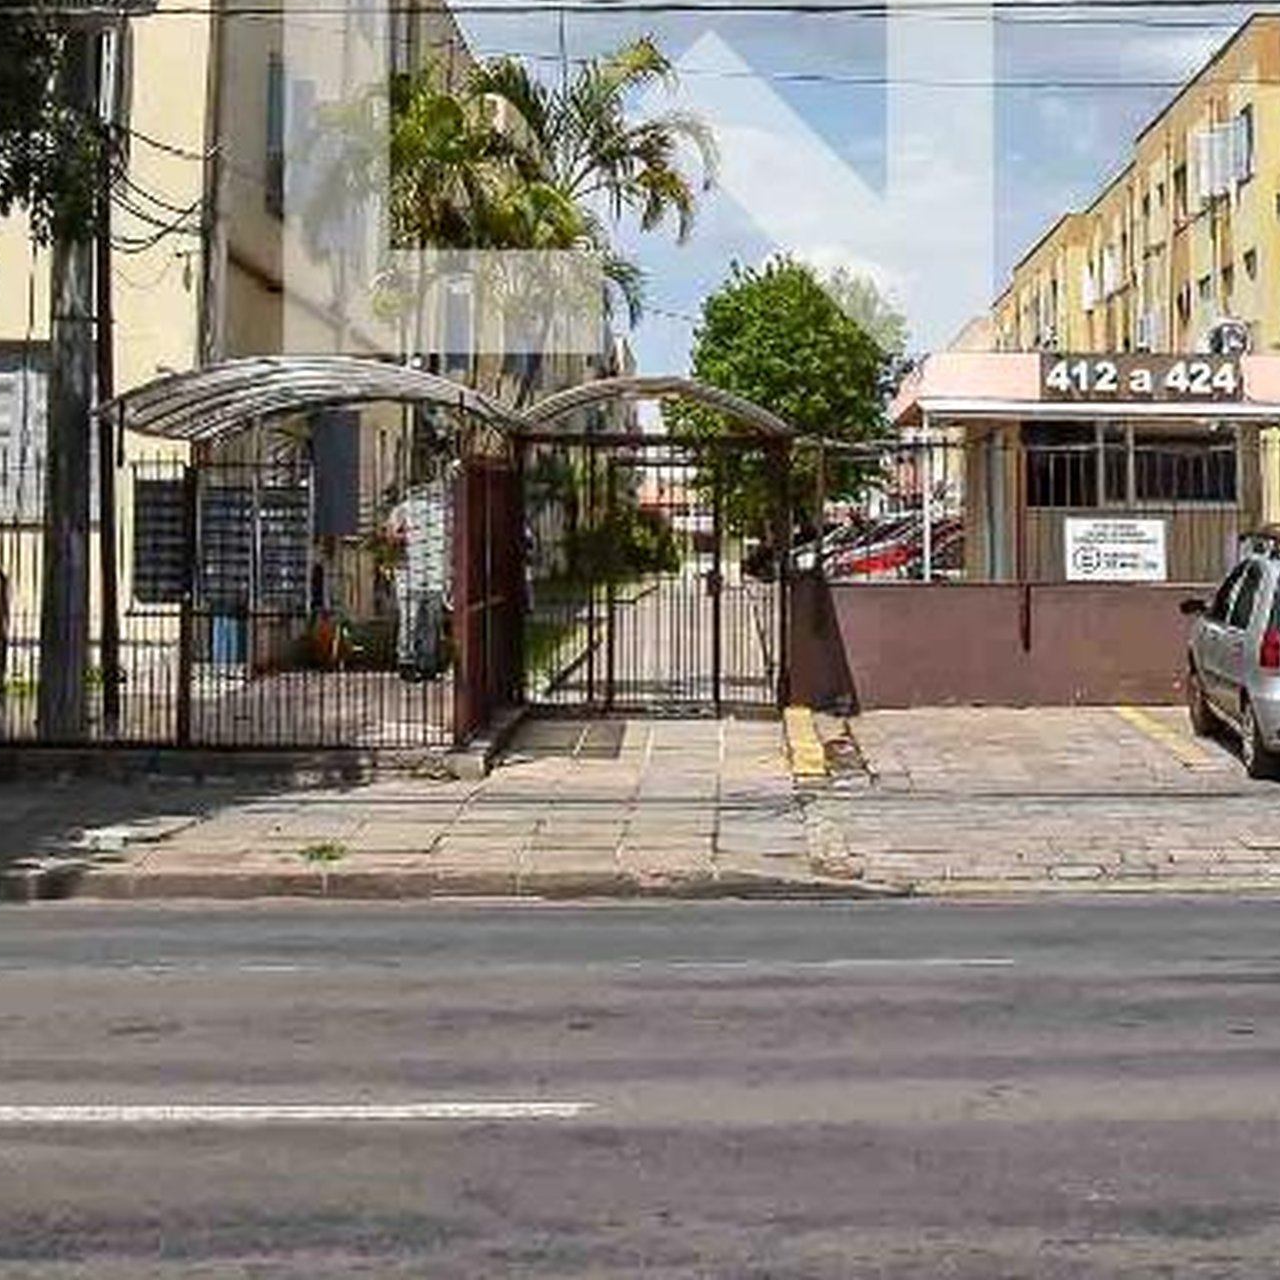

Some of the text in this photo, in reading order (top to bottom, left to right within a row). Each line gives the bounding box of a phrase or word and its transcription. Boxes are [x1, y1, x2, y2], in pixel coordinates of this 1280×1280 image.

[1046, 359, 1237, 394] 412 a 424
